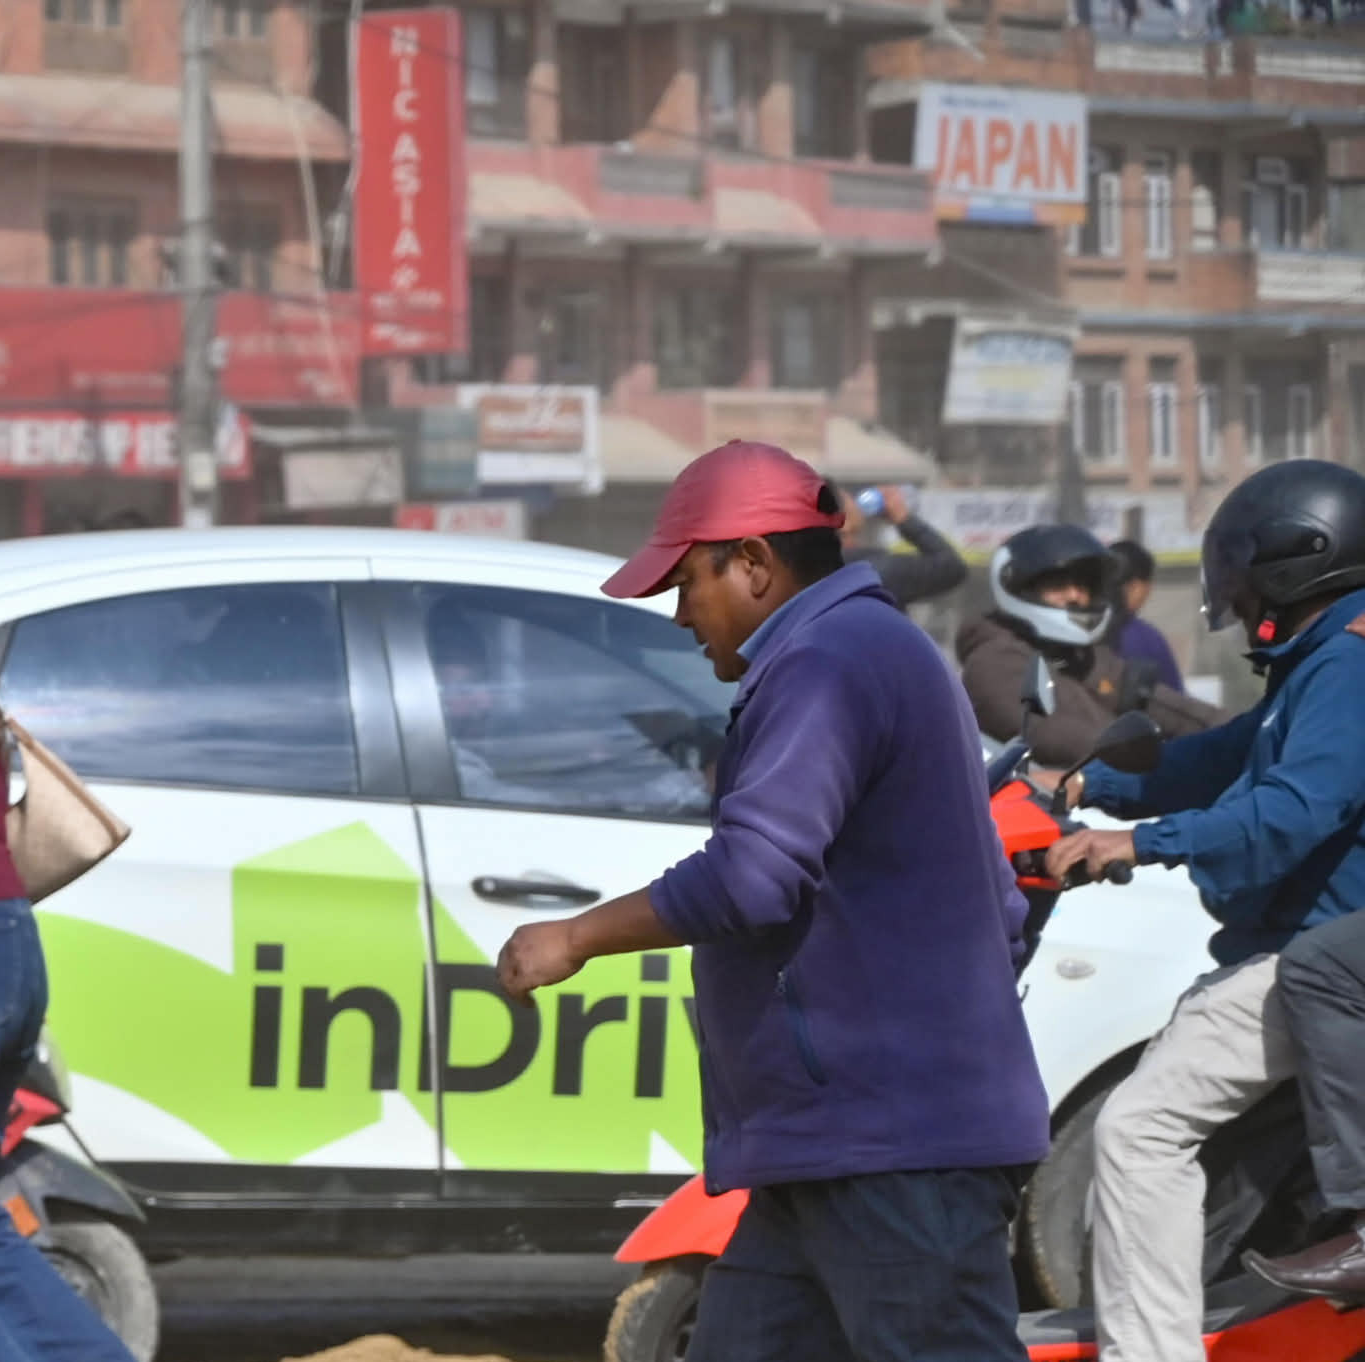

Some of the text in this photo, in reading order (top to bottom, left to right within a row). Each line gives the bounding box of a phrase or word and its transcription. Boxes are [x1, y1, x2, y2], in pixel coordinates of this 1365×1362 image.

[390, 26, 419, 120] NIC
[390, 132, 421, 258] ASIA
[935, 116, 1076, 189] JAPAN
